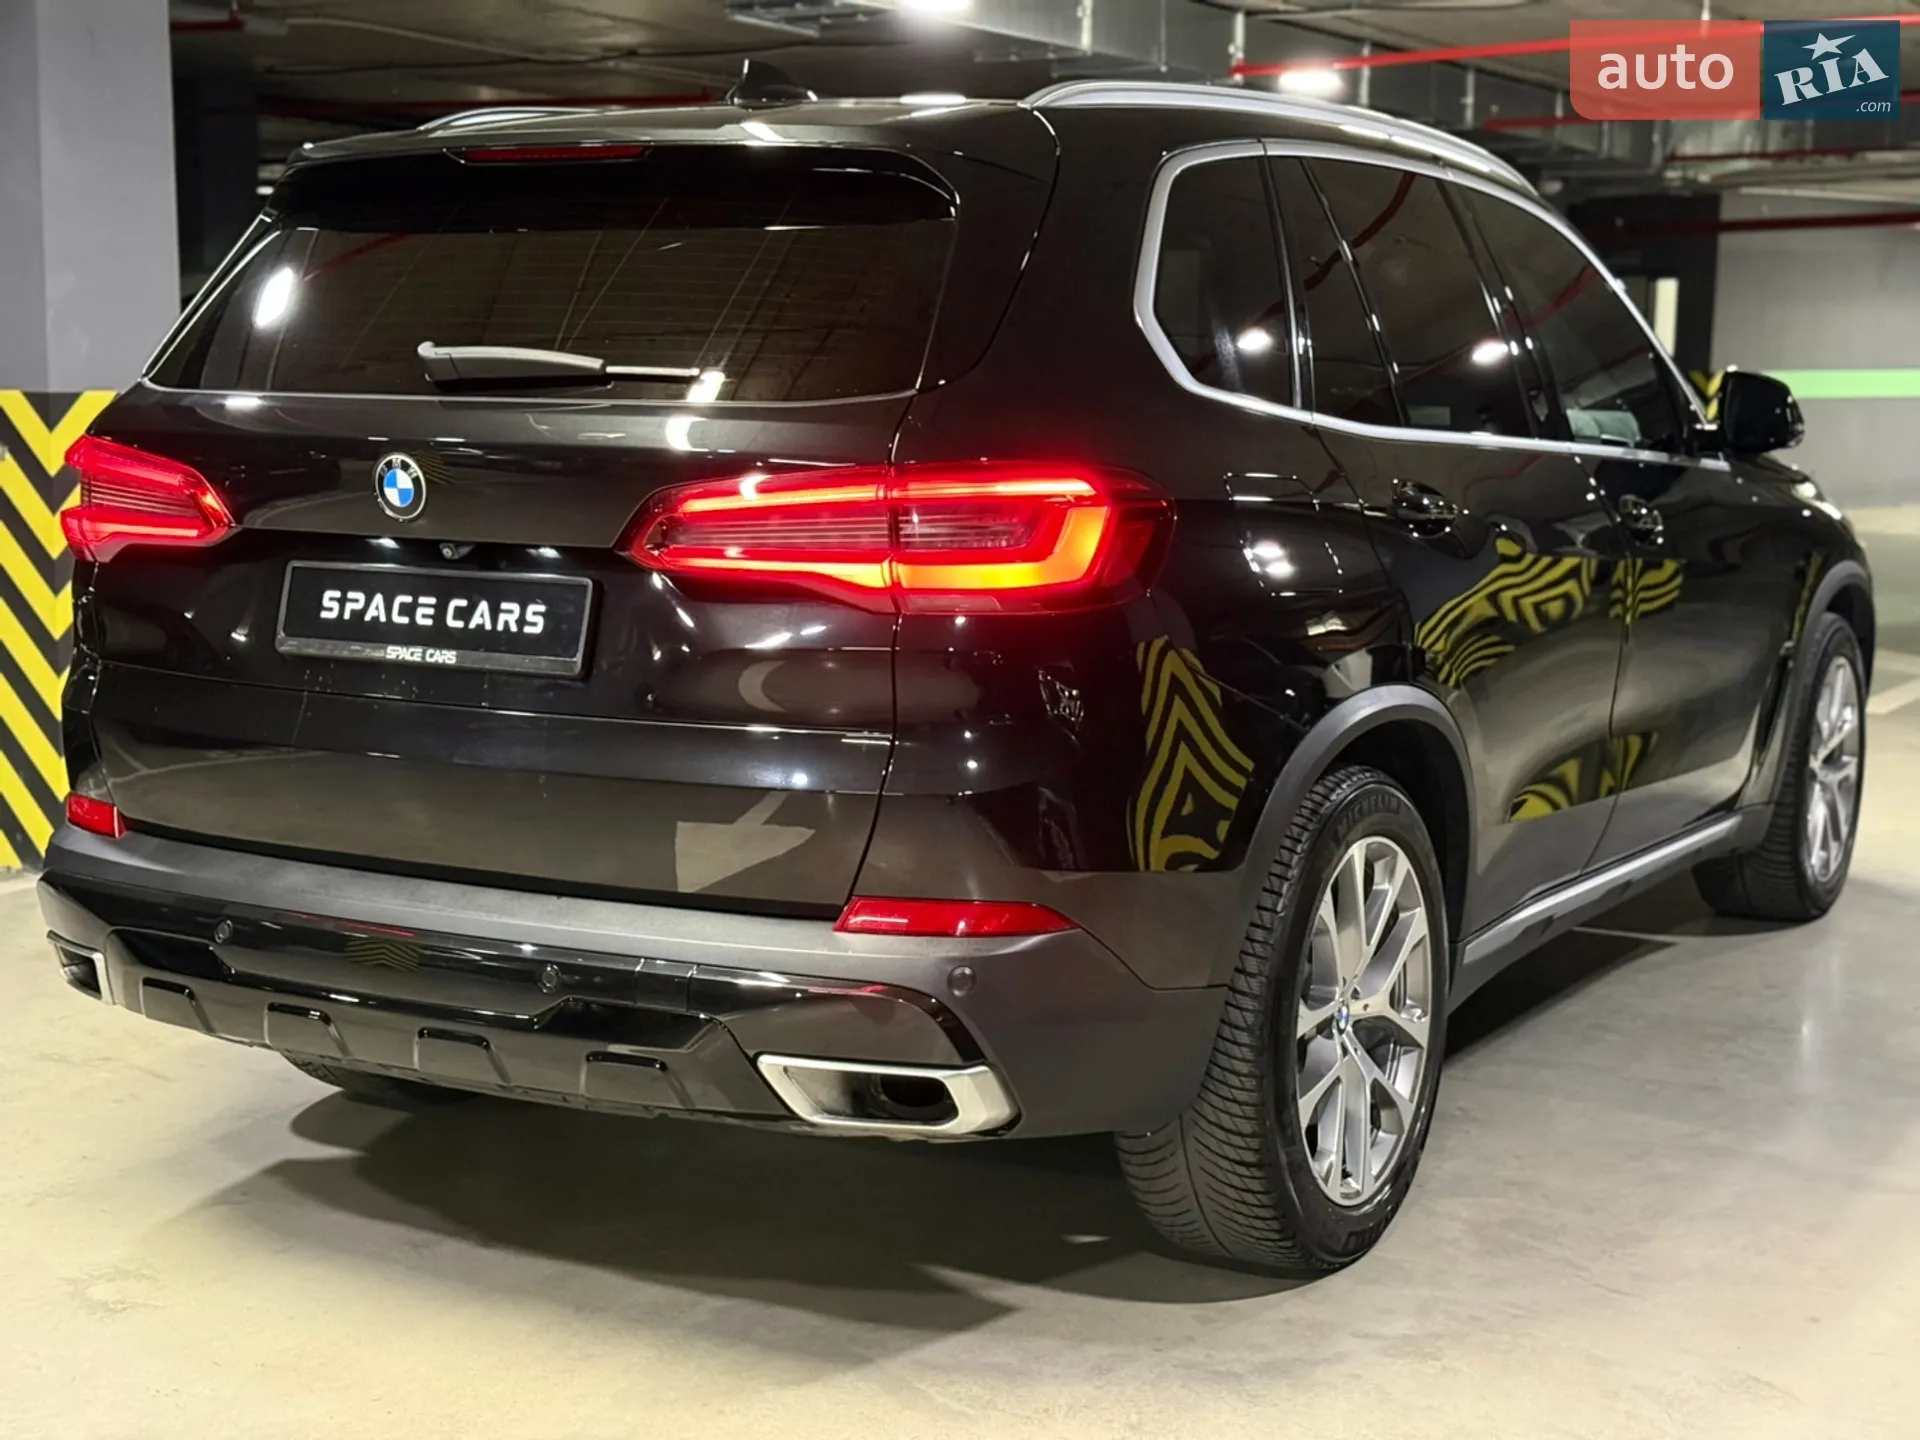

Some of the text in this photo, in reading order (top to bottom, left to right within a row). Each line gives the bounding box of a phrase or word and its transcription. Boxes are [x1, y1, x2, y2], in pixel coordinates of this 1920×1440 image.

[320, 590, 547, 634] SPACE CARS
[386, 645, 457, 664] SPACE CARS
